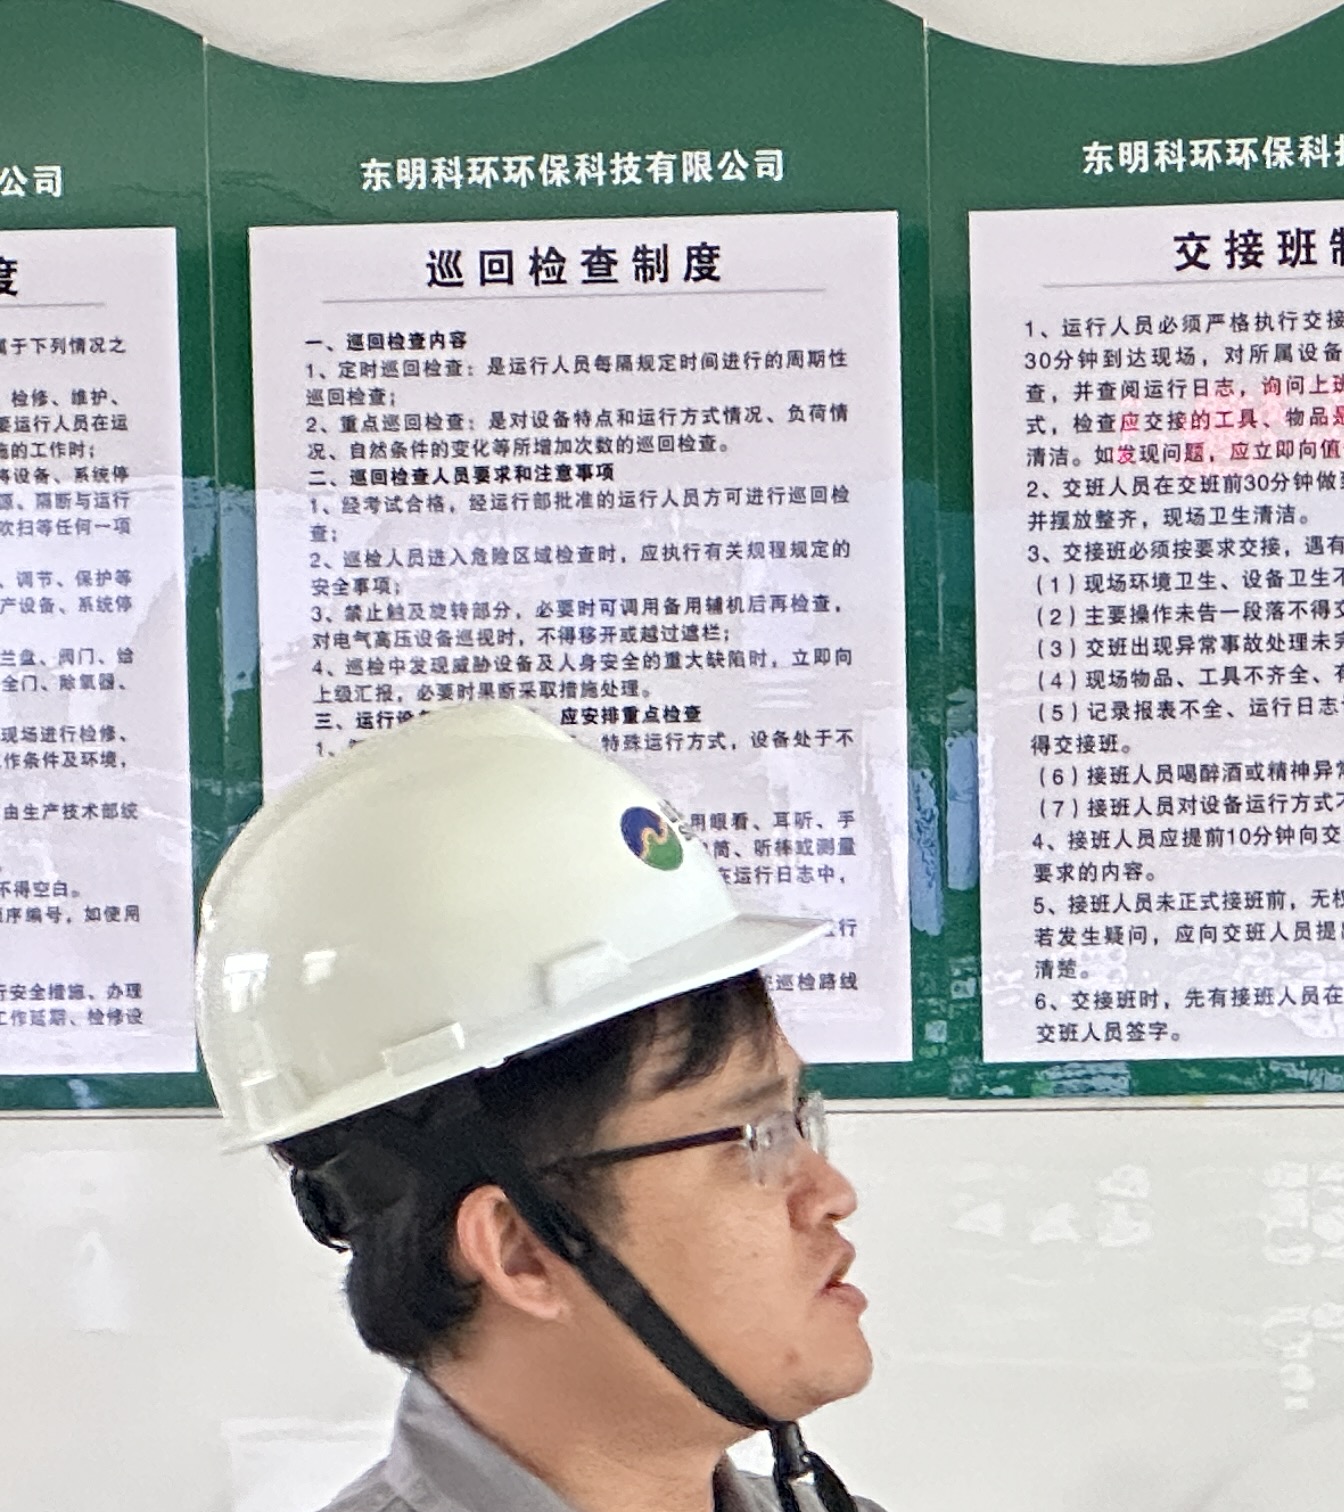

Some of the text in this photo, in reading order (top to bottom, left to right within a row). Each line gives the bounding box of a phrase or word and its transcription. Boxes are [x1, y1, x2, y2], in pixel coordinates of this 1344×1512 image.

[0, 165, 63, 197] 公司
[360, 149, 784, 191] 东明科环环保科技有限公司
[425, 242, 722, 287] 巡回检查制度
[304, 330, 468, 352] 一、巡回检查内容
[305, 349, 848, 379] 1、定时巡回检查：是运行人员每隔规定时间进行的周期性
[305, 387, 396, 407] 巡回检查；
[305, 403, 849, 433] 2、重点巡回检查：是对设备特点和运行方式情况、负荷情
[306, 434, 728, 460] 况、自然条件的变化等所增加次数的巡回检查。
[308, 463, 615, 486] 二、巡回检查人员要求和注意事项
[1027, 504, 1308, 531] 并摆放整齐，现场卫生清洁。
[314, 705, 702, 729] 三、运行设 应安排重点检查
[600, 729, 854, 752] 特殊运行方式，设备处于不
[1030, 734, 1131, 756] 得交接班。
[0, 751, 127, 769] 作条件及环境，
[702, 837, 857, 858] 筒、听棒或测量
[1033, 861, 1155, 883] 要求的内容。
[1034, 958, 1089, 979] 清楚。
[1036, 1021, 1180, 1043] 交班人员签字。
